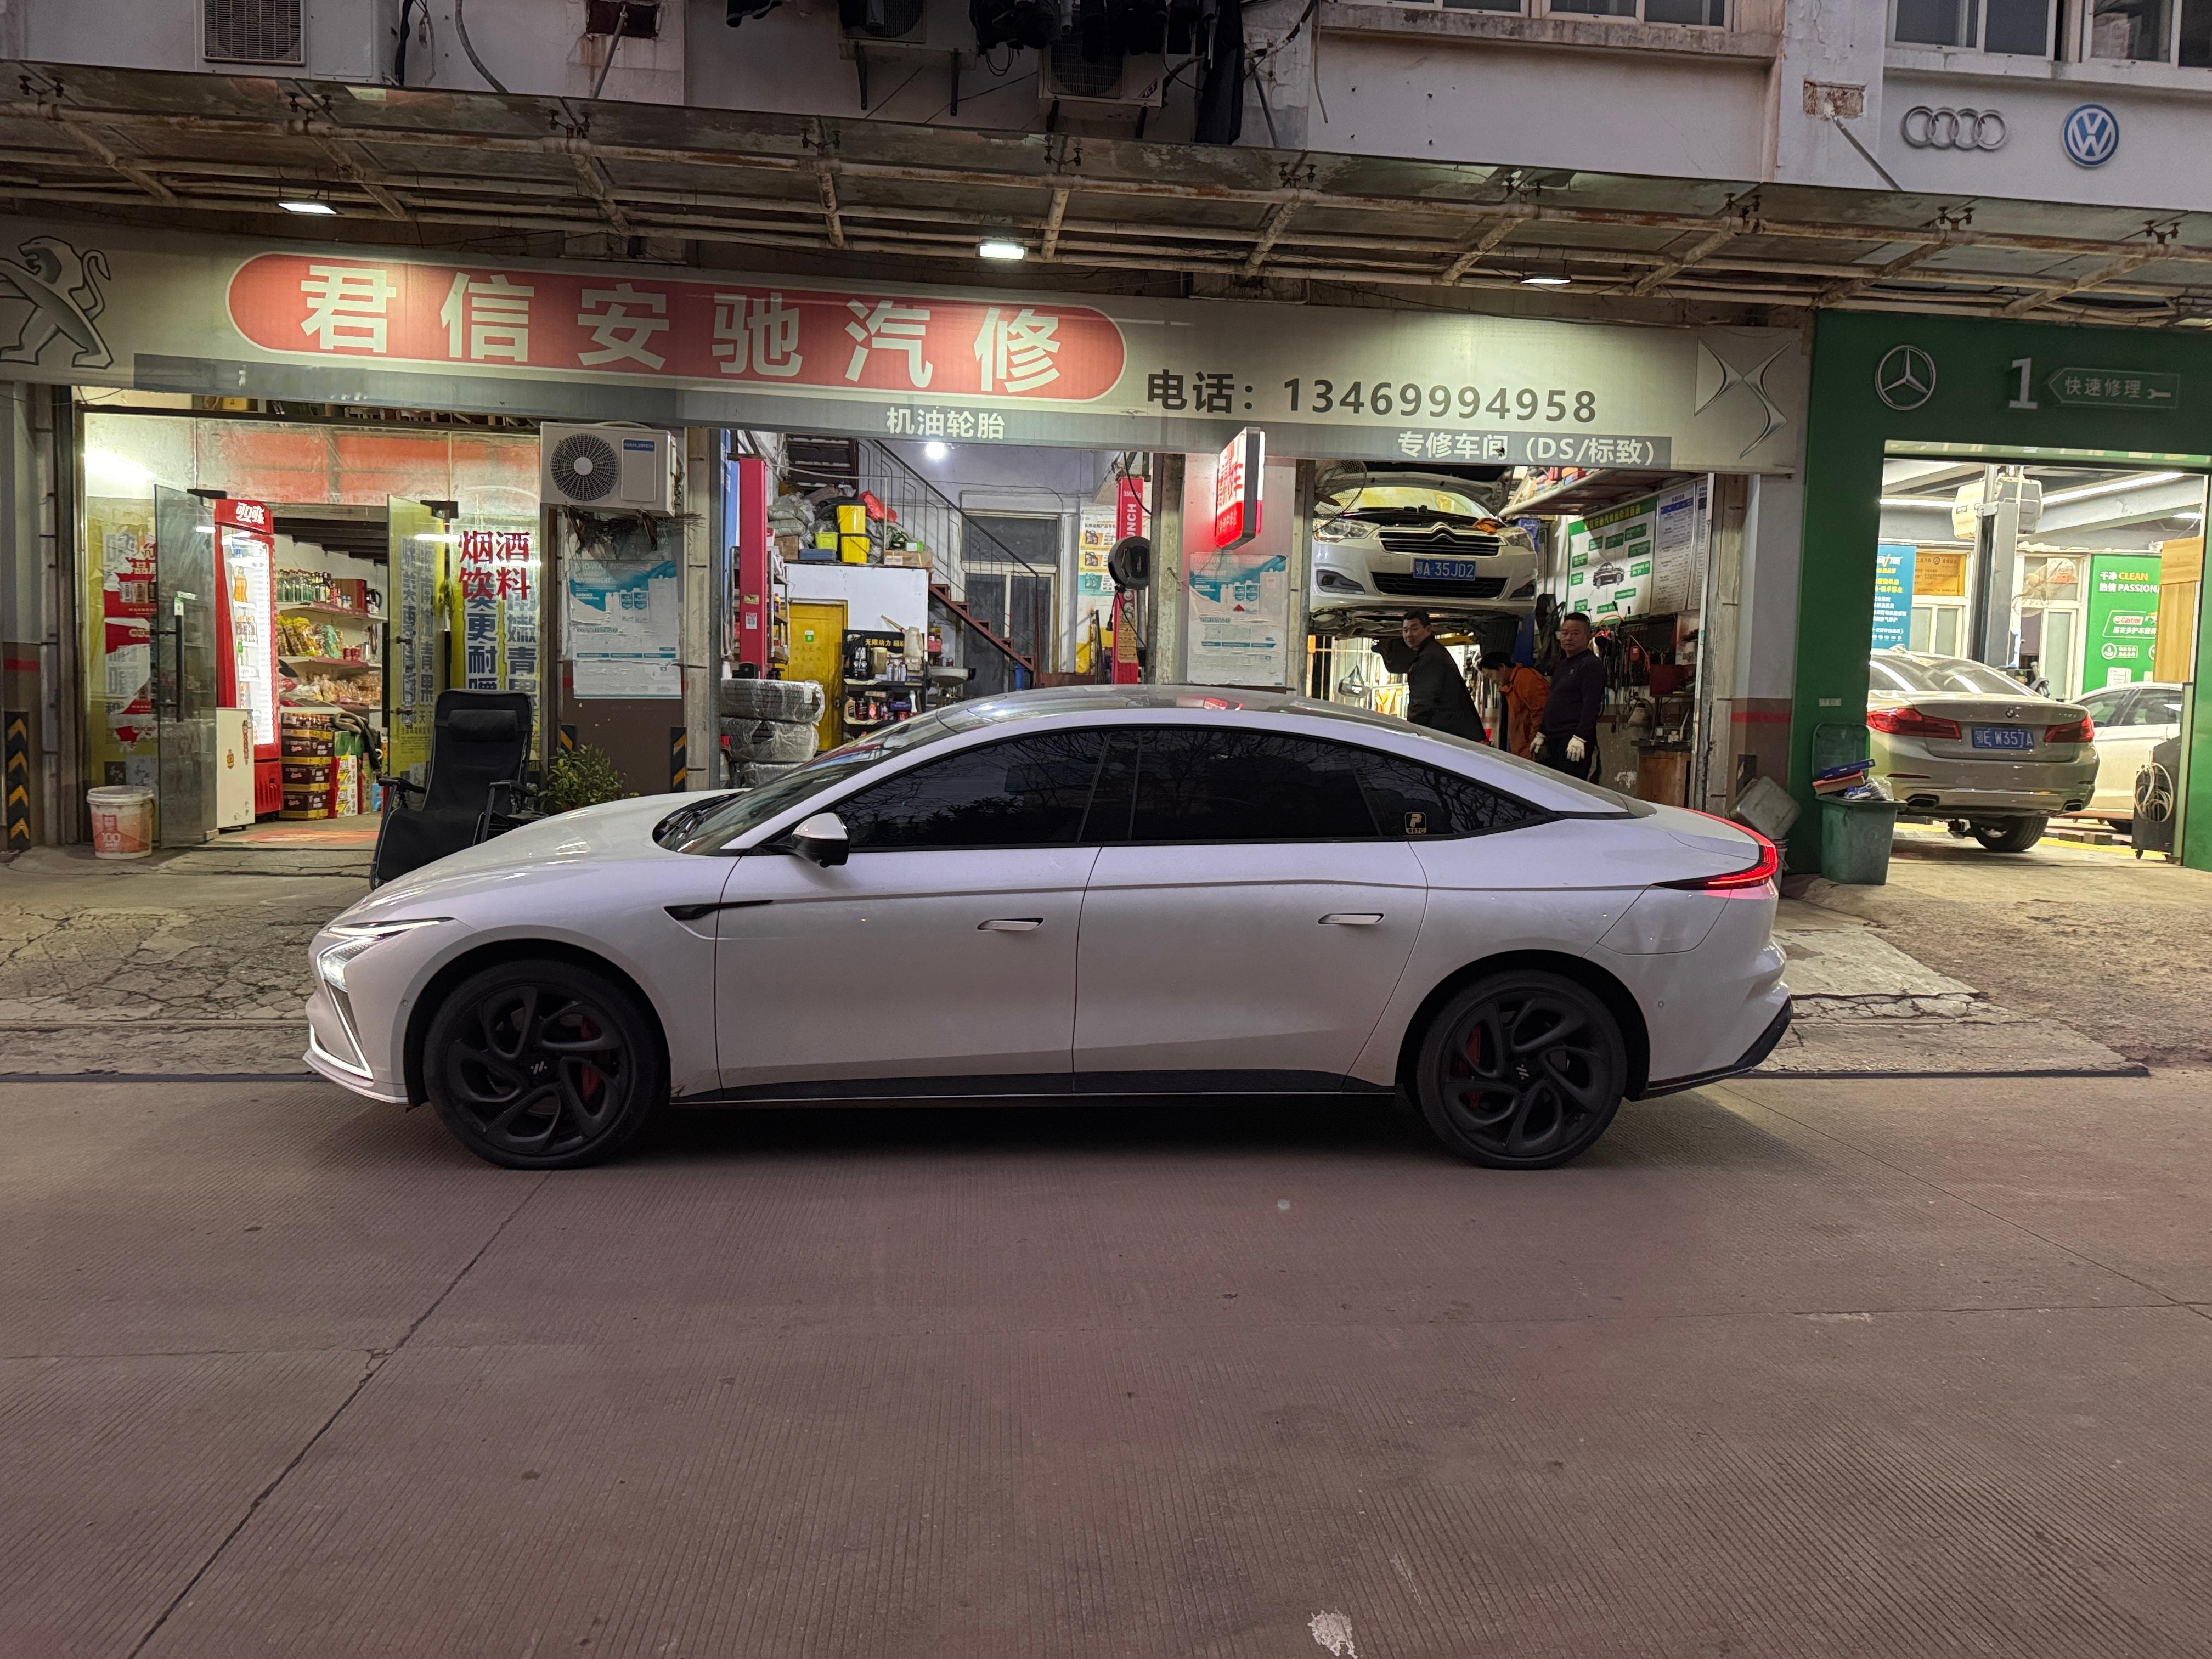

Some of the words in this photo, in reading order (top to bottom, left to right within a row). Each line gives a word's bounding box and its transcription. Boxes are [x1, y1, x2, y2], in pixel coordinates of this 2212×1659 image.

[300, 264, 1061, 393] 君信安驰汽修
[1284, 377, 1597, 423] 13469994958
[2008, 357, 2038, 410] 1
[2063, 376, 2141, 399] 快速修理
[886, 407, 1005, 440] 机油轮胎
[458, 530, 531, 564] 烟酒
[459, 566, 531, 600] 饮料
[2100, 571, 2118, 581] 干净
[2118, 572, 2148, 581] CLEAN
[2121, 616, 2141, 624] Castrol
[865, 638, 891, 646] 无限动力
